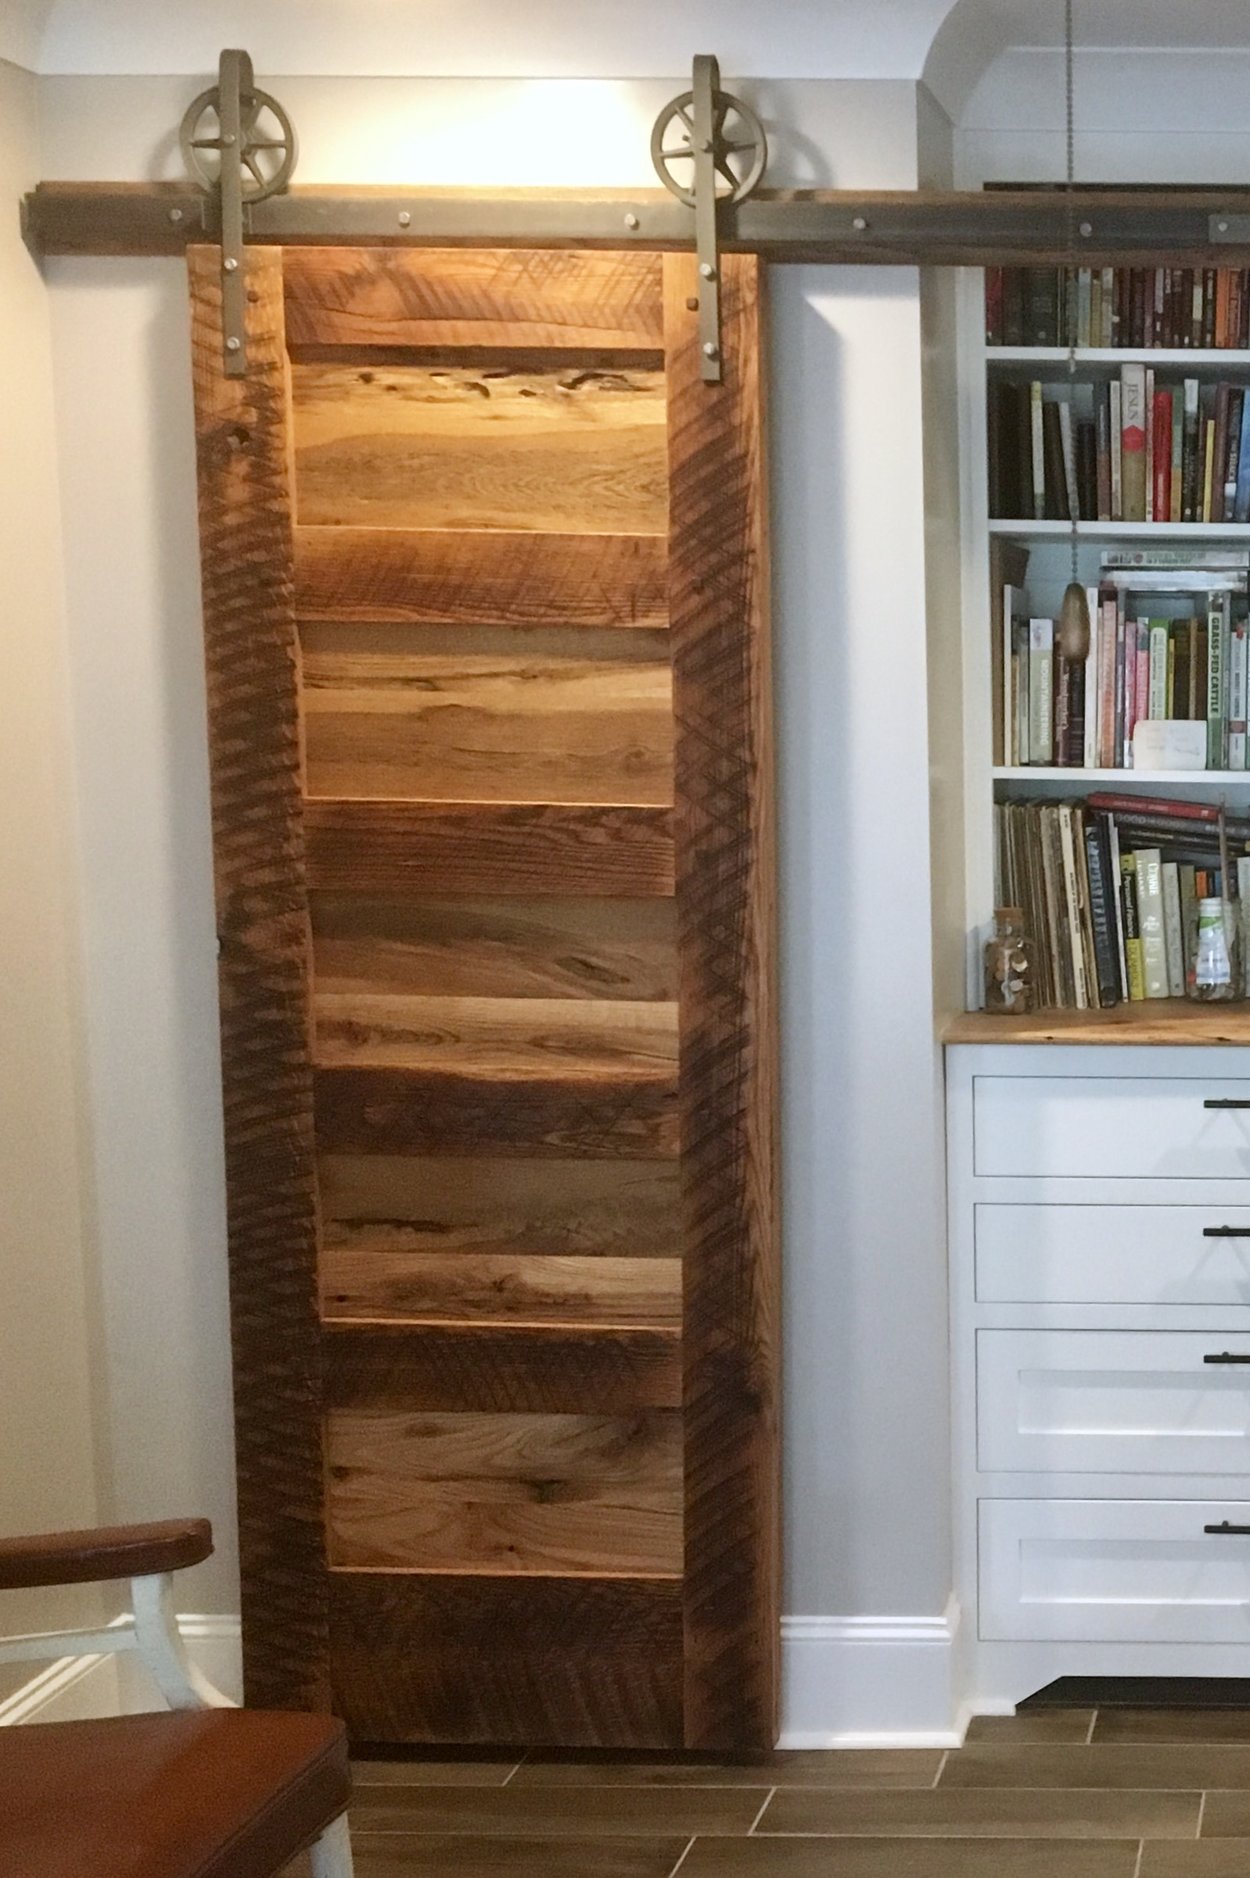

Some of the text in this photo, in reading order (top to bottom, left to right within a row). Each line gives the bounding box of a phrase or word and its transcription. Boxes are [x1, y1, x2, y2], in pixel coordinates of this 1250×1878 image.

[1127, 383, 1139, 420] JESUS
[1040, 659, 1049, 745] MOUNTAINEERING
[1210, 617, 1221, 713] GRASS-FED CATTLE
[1124, 876, 1135, 938] Personal Finance
